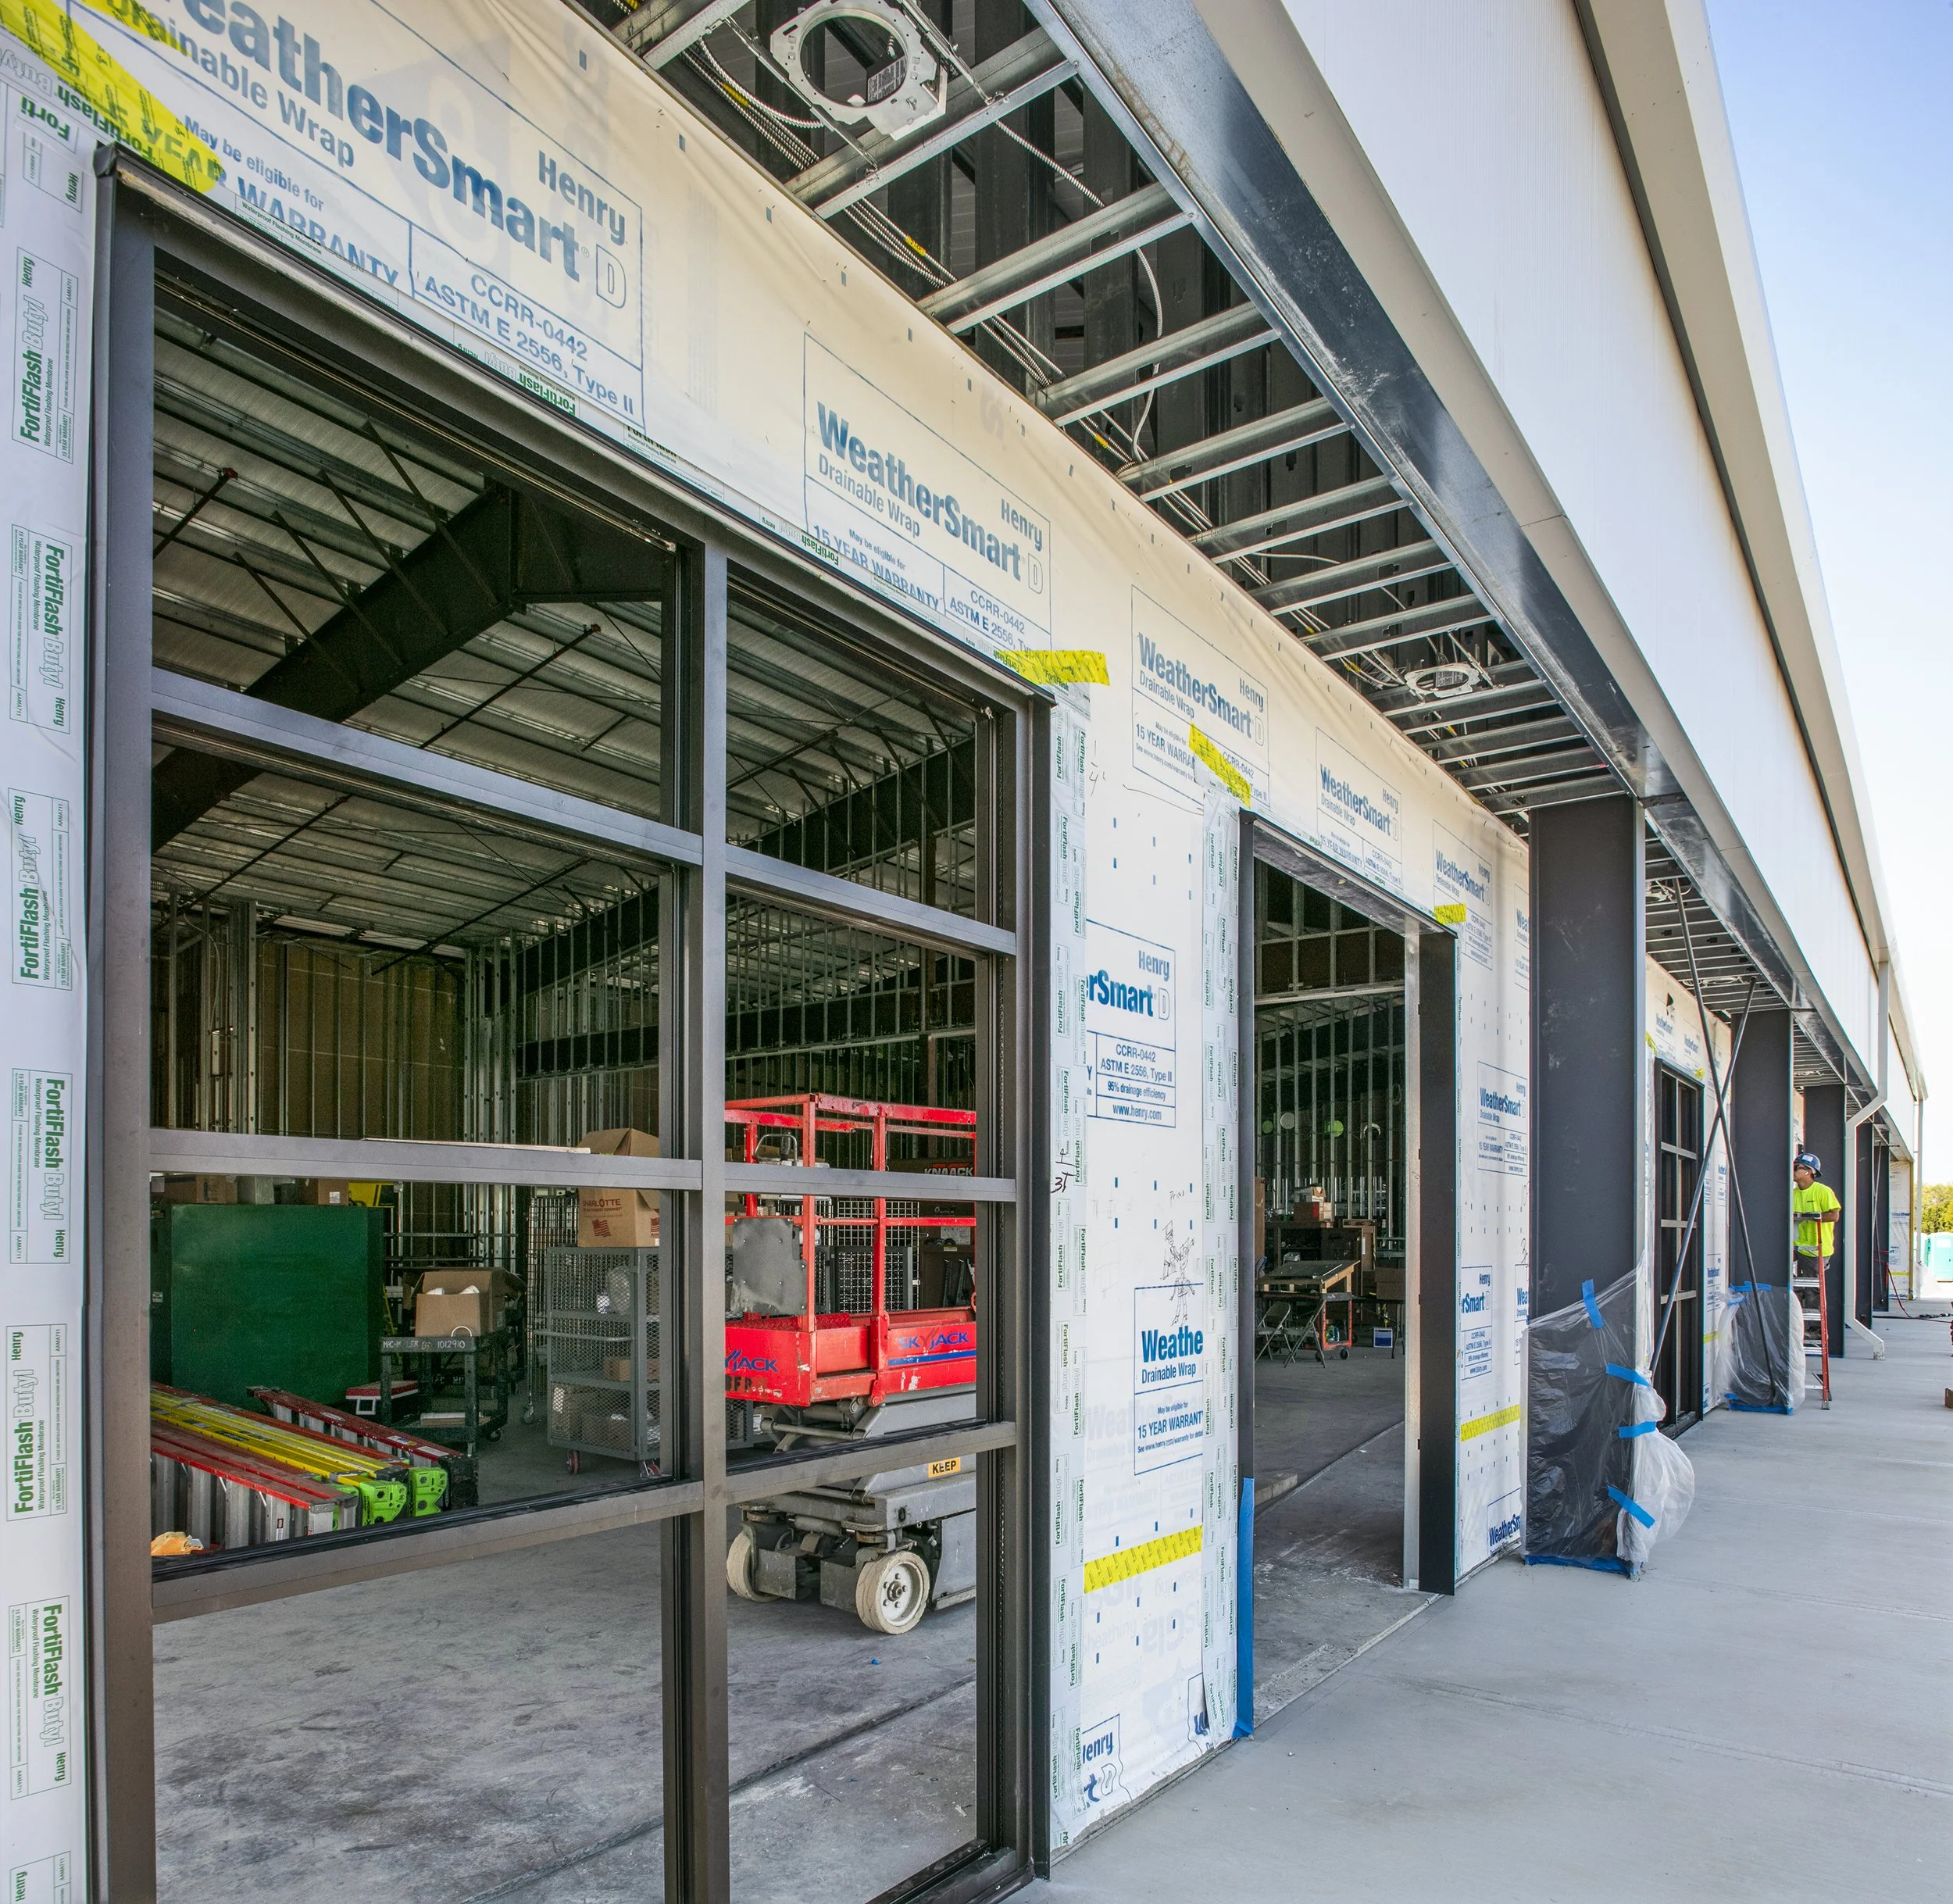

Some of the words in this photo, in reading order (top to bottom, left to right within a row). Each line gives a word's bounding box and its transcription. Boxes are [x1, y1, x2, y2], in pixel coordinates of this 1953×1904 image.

[20, 95, 71, 142] Forti
[277, 88, 355, 169] Wrap
[184, 114, 218, 150] May
[223, 138, 243, 163] be
[246, 155, 302, 199] eligible
[304, 186, 325, 213] for
[66, 171, 79, 204] Henry
[538, 149, 627, 246] Henry
[237, 176, 399, 287] WARRANTY
[241, 201, 273, 226] Waterproof
[272, 220, 295, 240] Flashing
[295, 234, 323, 255] Membrane
[21, 257, 35, 288] Henry
[22, 295, 48, 350] Butyl
[470, 273, 588, 362] CCRR-0442
[424, 275, 491, 329] ASTM
[497, 317, 512, 343] E
[516, 330, 569, 379] 2556,
[572, 363, 619, 406] Type
[45, 359, 53, 390] Membrane
[20, 350, 42, 443] FortiFlash
[45, 390, 54, 415] Flashing
[44, 415, 52, 447] Waterproof
[816, 400, 1022, 582] WeatherSmart
[819, 452, 884, 515] Drainable
[887, 498, 920, 538] Wrap
[1001, 498, 1043, 552] Henry
[33, 540, 42, 573] Waterproof
[802, 534, 839, 567] FortiFlash
[849, 529, 863, 546] May
[864, 538, 873, 550] be
[873, 545, 896, 565] eligible
[897, 559, 906, 571] for
[32, 573, 41, 598] Flashing
[44, 543, 65, 636] FortiFlash
[834, 535, 869, 570] YEAR
[872, 559, 939, 611] WARRANTY
[950, 596, 980, 626] ASTM
[982, 616, 990, 632] E
[991, 621, 1016, 650] 2556,
[969, 589, 1026, 635] CCRR-0442
[39, 637, 64, 689] Butyl
[1137, 631, 1252, 739] WeatherSmart
[1140, 670, 1175, 706] Drainable
[1176, 695, 1194, 720] Wrap
[1239, 677, 1264, 713] Henry
[53, 697, 66, 727] Henry
[1136, 723, 1145, 740] 15
[1147, 728, 1166, 752] YEAR
[1222, 751, 1255, 779] CCRR-0442
[14, 796, 26, 826] Henry
[1319, 763, 1391, 837] WeatherSmart
[1382, 788, 1399, 814] Henry
[18, 834, 41, 884] Butyl
[1435, 848, 1485, 902] WeatherSmart
[20, 888, 39, 979] FortiFlash
[42, 923, 52, 948] Flashing
[42, 949, 51, 980] Waterproof
[1138, 949, 1170, 982] Henry
[1087, 969, 1154, 1017] rSmart
[1116, 1044, 1156, 1063] CCRR-0442
[1100, 1058, 1123, 1073] ASTM
[1123, 1062, 1130, 1074] E
[1130, 1063, 1149, 1080] 2556,
[1150, 1068, 1166, 1083] Type
[34, 1077, 43, 1110] Waterproof
[1107, 1081, 1119, 1092] 95%
[1120, 1083, 1143, 1098] drainage
[1143, 1087, 1166, 1102] efficiency
[1480, 1087, 1522, 1117] WeatherSmart
[33, 1111, 42, 1136] Flashing
[45, 1078, 66, 1169] FortiFlash
[1112, 1104, 1162, 1121] www.henry.com
[924, 1166, 974, 1177] KNAACK
[40, 1172, 65, 1220] Butyl
[583, 1198, 622, 1207] CHARLOTTE
[53, 1229, 66, 1258] Henry
[1478, 1274, 1491, 1287] Henry
[11, 1331, 23, 1361] Henry
[898, 1327, 970, 1350] SKYJACK
[1141, 1325, 1203, 1363] Weathe
[1141, 1364, 1176, 1384] Drainable
[1177, 1362, 1196, 1378] Wrap
[13, 1369, 38, 1418] Butyl
[1171, 1402, 1184, 1413] eligible
[1137, 1424, 1147, 1440] 15
[1148, 1419, 1167, 1438] YEAR
[1169, 1409, 1203, 1431] WARRANT
[14, 1421, 34, 1513] FortiFlash
[37, 1452, 46, 1477] Flashing
[932, 1459, 957, 1475] KEEP
[37, 1477, 46, 1510] Waterproof
[31, 1608, 40, 1641] Waterproof
[30, 1641, 39, 1667] Flashing
[43, 1603, 62, 1696] FortiFlash
[39, 1696, 64, 1747] Butyl
[54, 1752, 66, 1781] Henry
[15, 1870, 28, 1902] Henry
